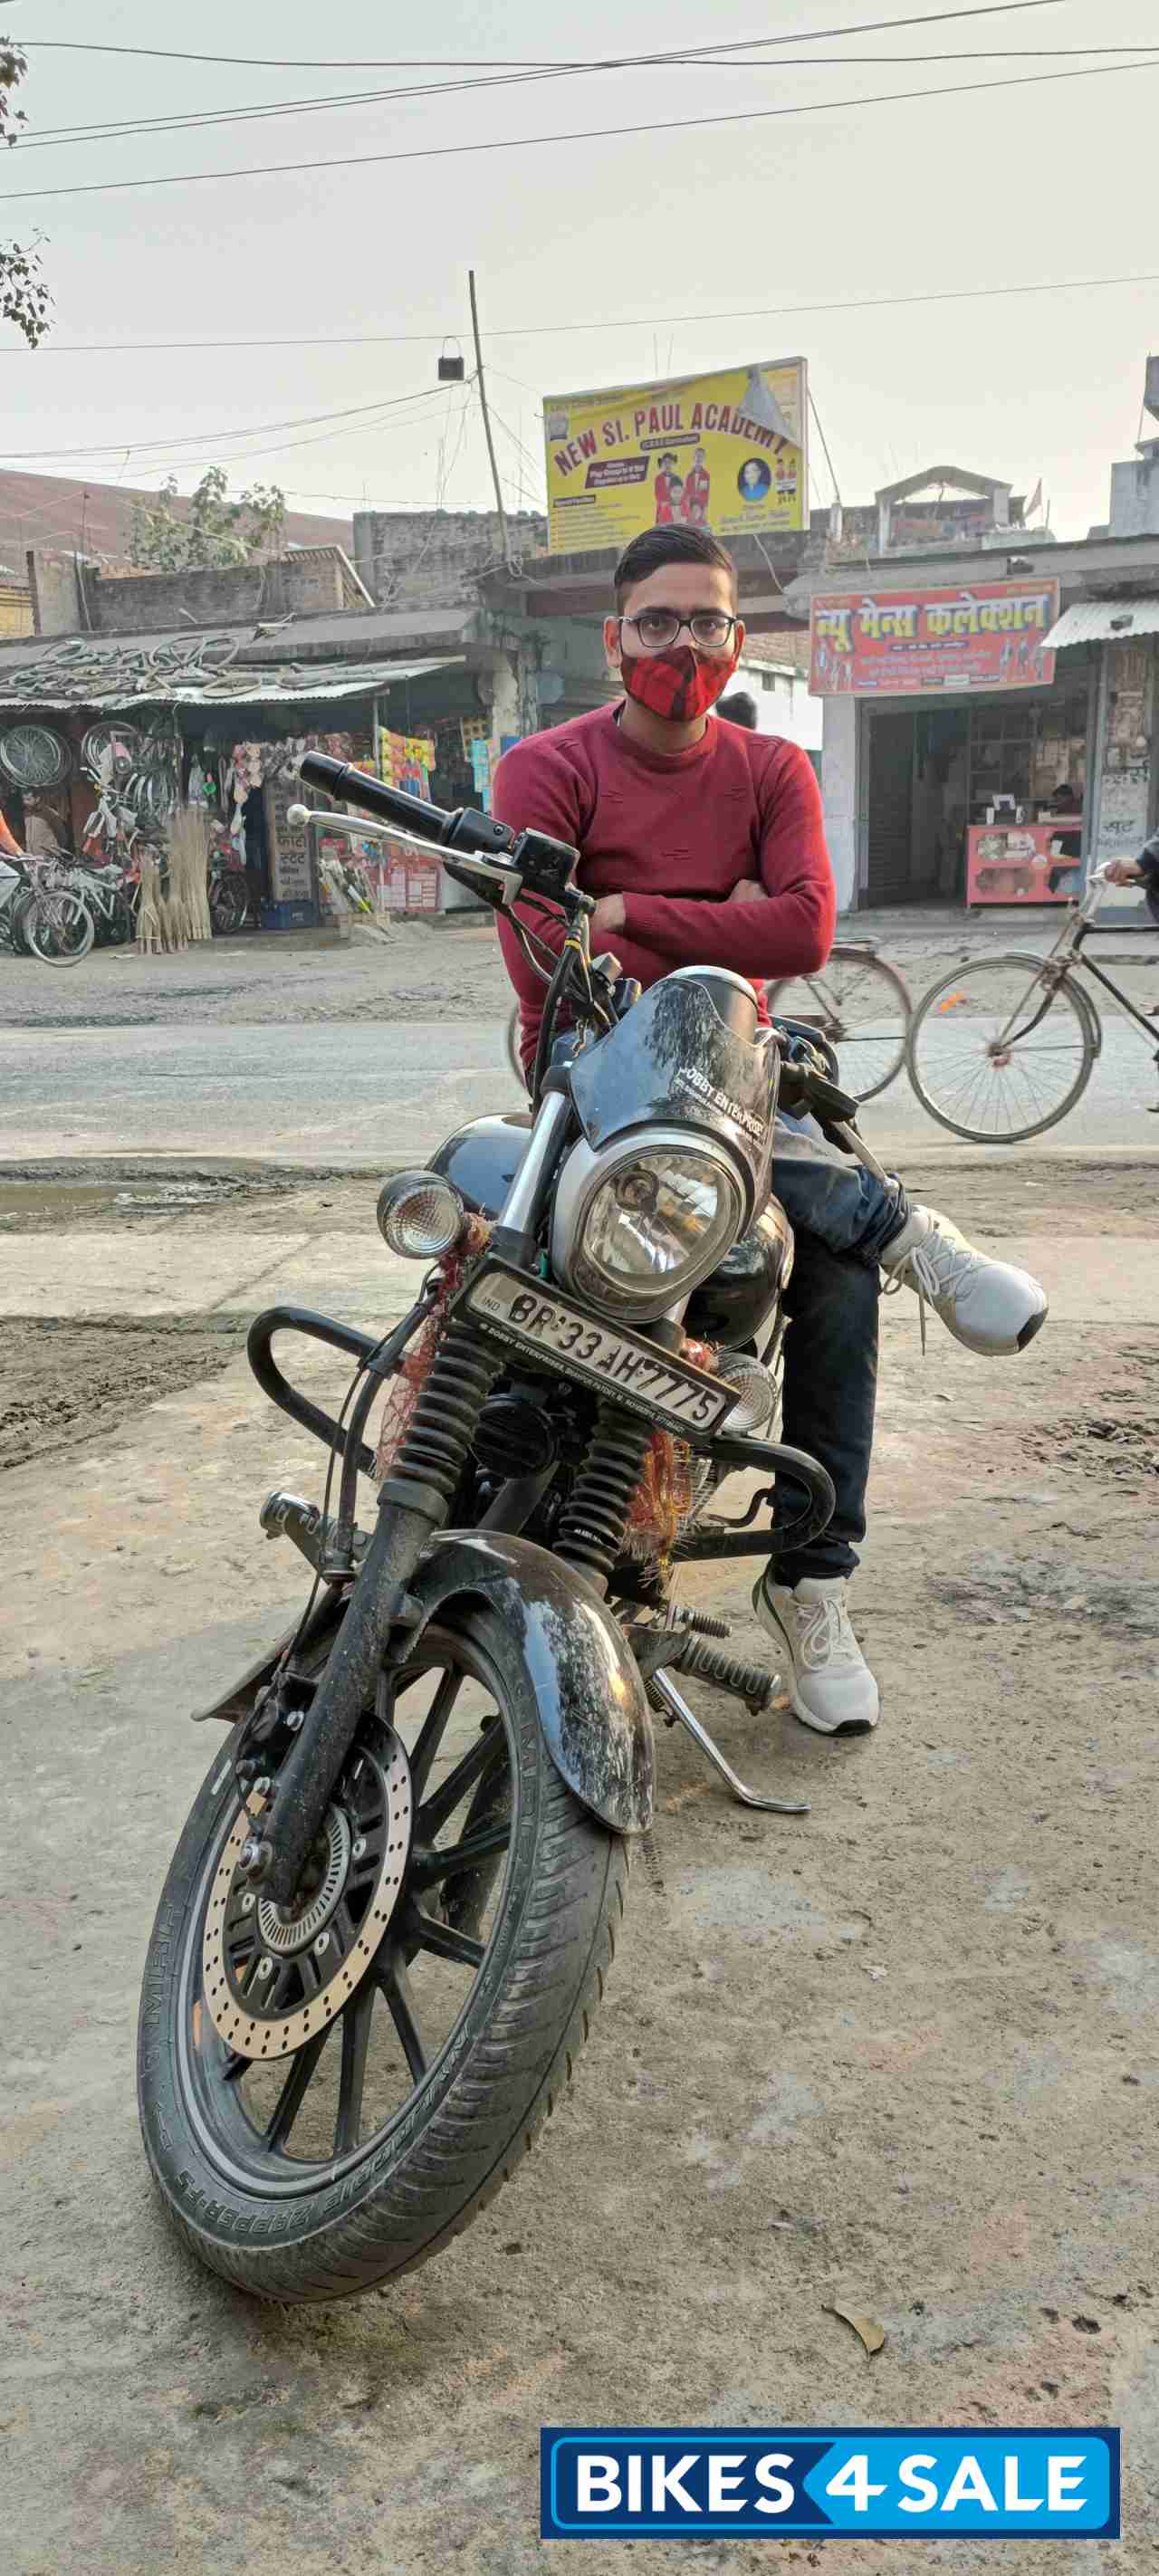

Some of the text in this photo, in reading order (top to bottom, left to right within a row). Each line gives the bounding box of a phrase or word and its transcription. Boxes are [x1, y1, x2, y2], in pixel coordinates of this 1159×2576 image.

[554, 429, 597, 476] NEW
[634, 404, 684, 437] PAUL
[814, 591, 1050, 654] न्यू मेन्स कलेक्शन
[483, 1296, 501, 1312] IND
